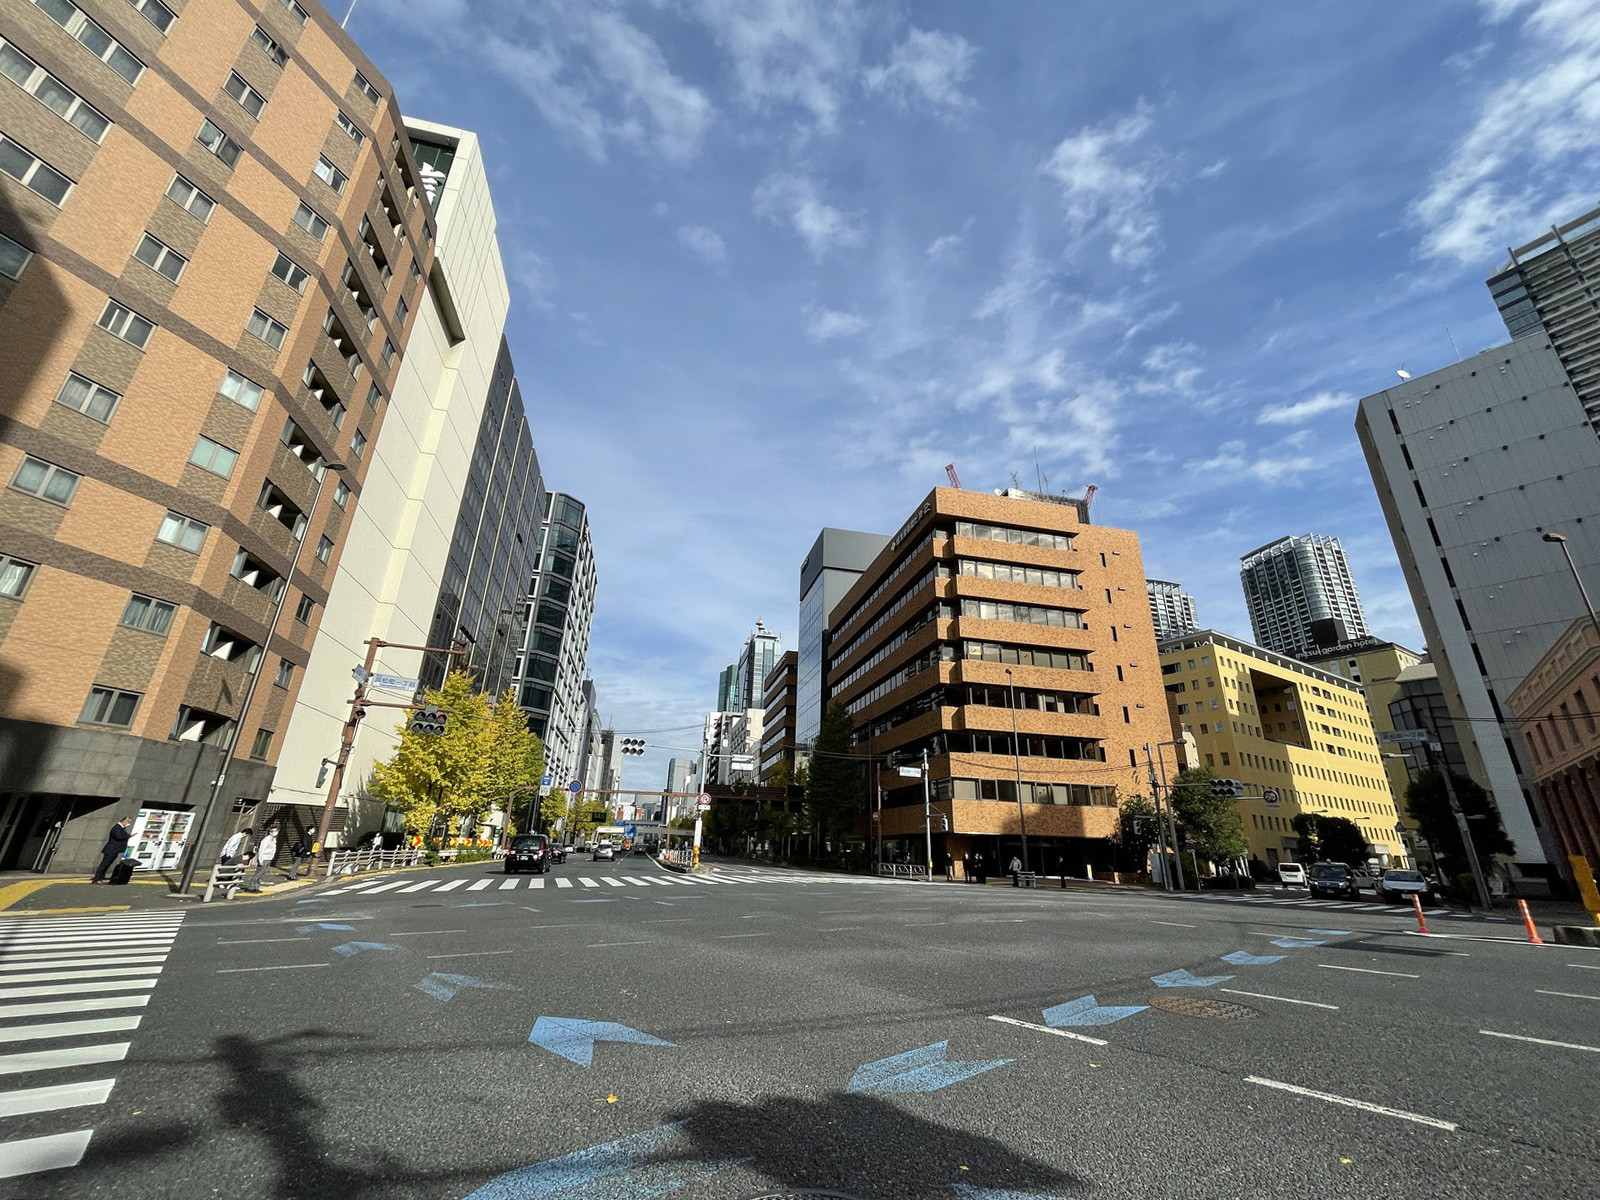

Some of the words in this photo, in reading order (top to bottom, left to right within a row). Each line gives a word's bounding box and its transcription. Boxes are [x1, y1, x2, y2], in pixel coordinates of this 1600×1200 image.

[1295, 644, 1322, 659] mitsui
[1321, 640, 1353, 655] garden
[1353, 638, 1379, 648] hotel
